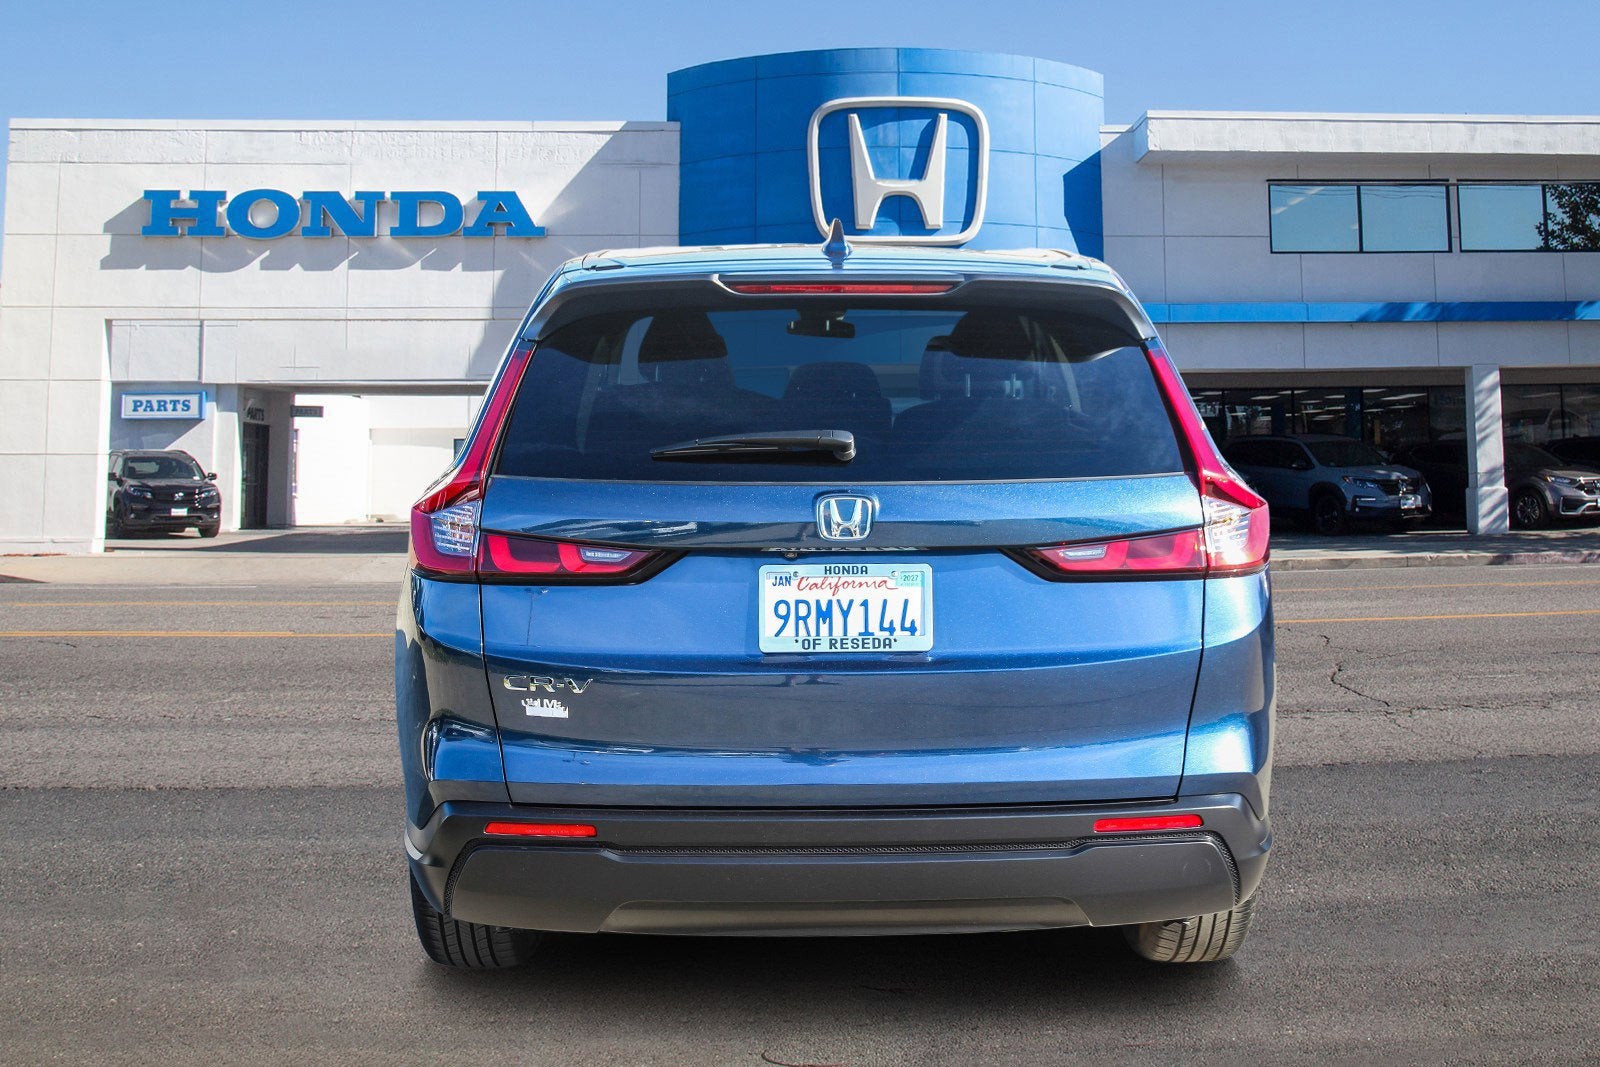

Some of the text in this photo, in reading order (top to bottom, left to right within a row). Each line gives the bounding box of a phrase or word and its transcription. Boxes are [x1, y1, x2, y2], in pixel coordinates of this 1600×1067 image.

[141, 188, 547, 238] HONDA
[132, 399, 191, 413] PARTS
[824, 565, 869, 575] HONDA
[771, 575, 792, 587] JAN
[903, 574, 919, 582] 2027
[796, 576, 898, 596] California
[773, 598, 918, 637] 9RMY144
[801, 637, 893, 650] OF RESEDA
[503, 674, 594, 694] CR-V
